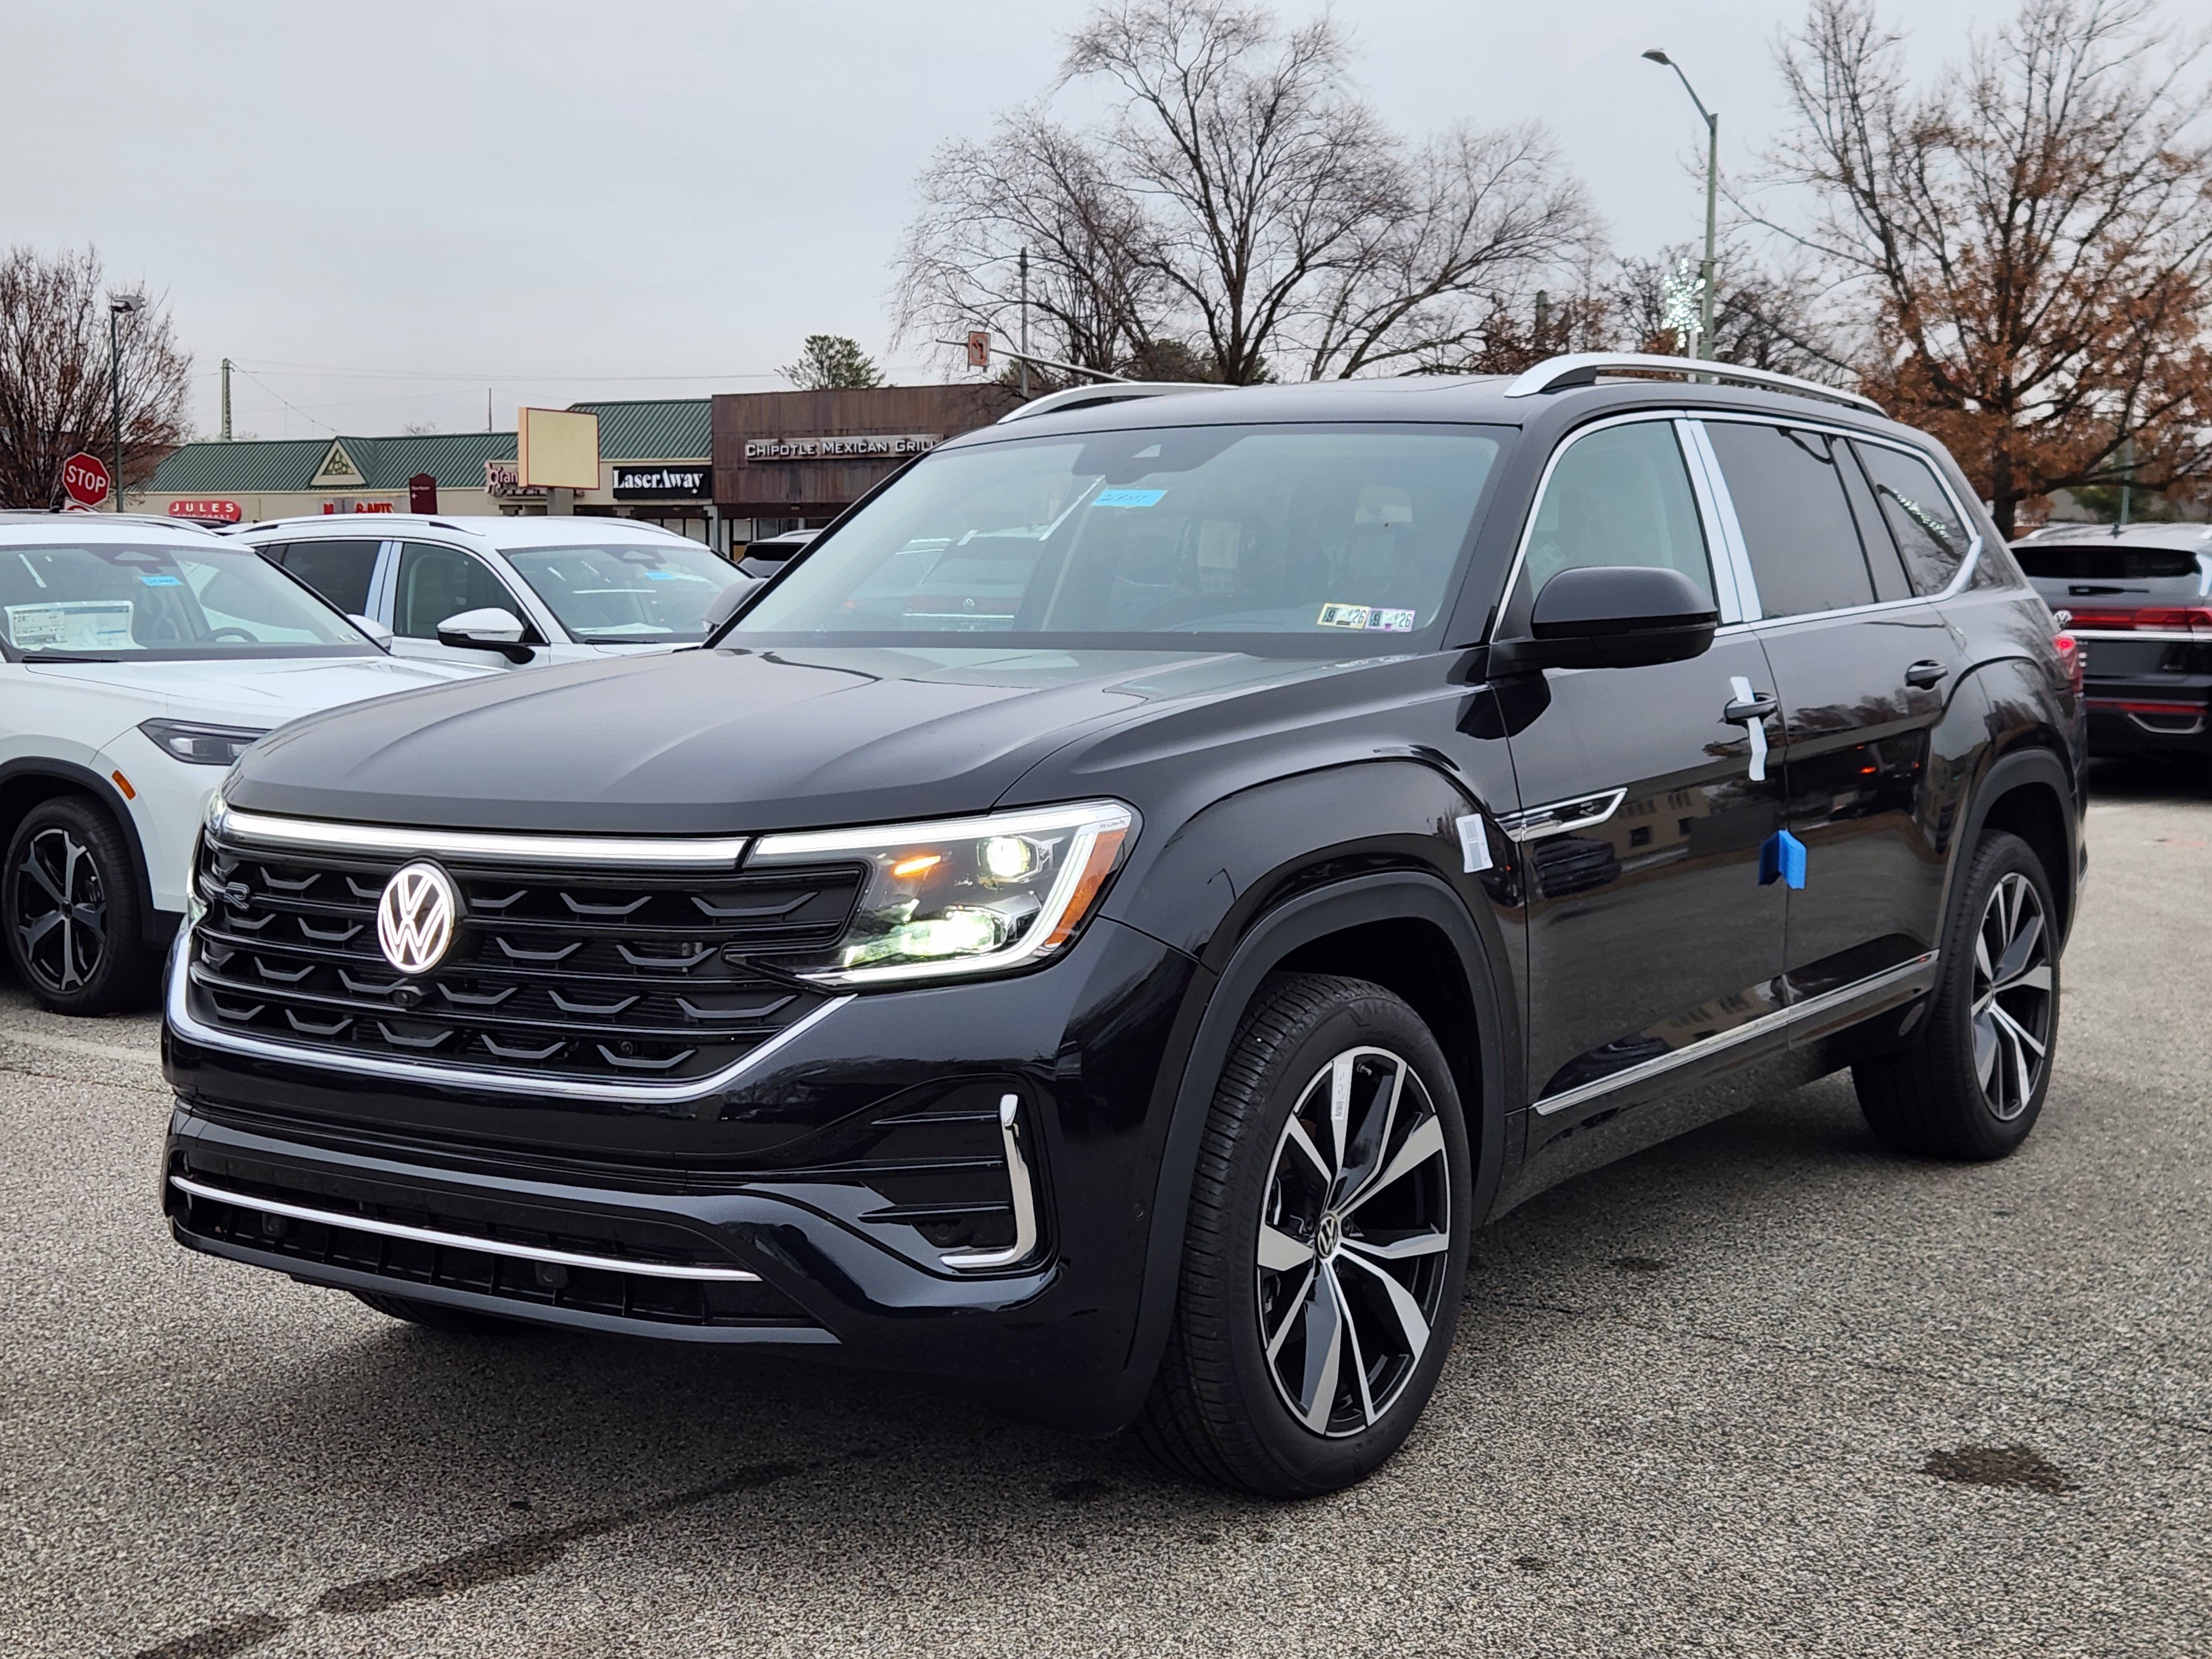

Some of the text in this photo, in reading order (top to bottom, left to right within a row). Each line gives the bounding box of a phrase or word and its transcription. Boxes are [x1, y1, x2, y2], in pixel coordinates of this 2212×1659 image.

[747, 444, 815, 456] CHIPOTLE
[822, 442, 887, 454] MEXICAN
[66, 465, 106, 493] STOP
[613, 469, 703, 494] LaserAway
[172, 502, 234, 513] JULES
[1399, 613, 1412, 628] 26
